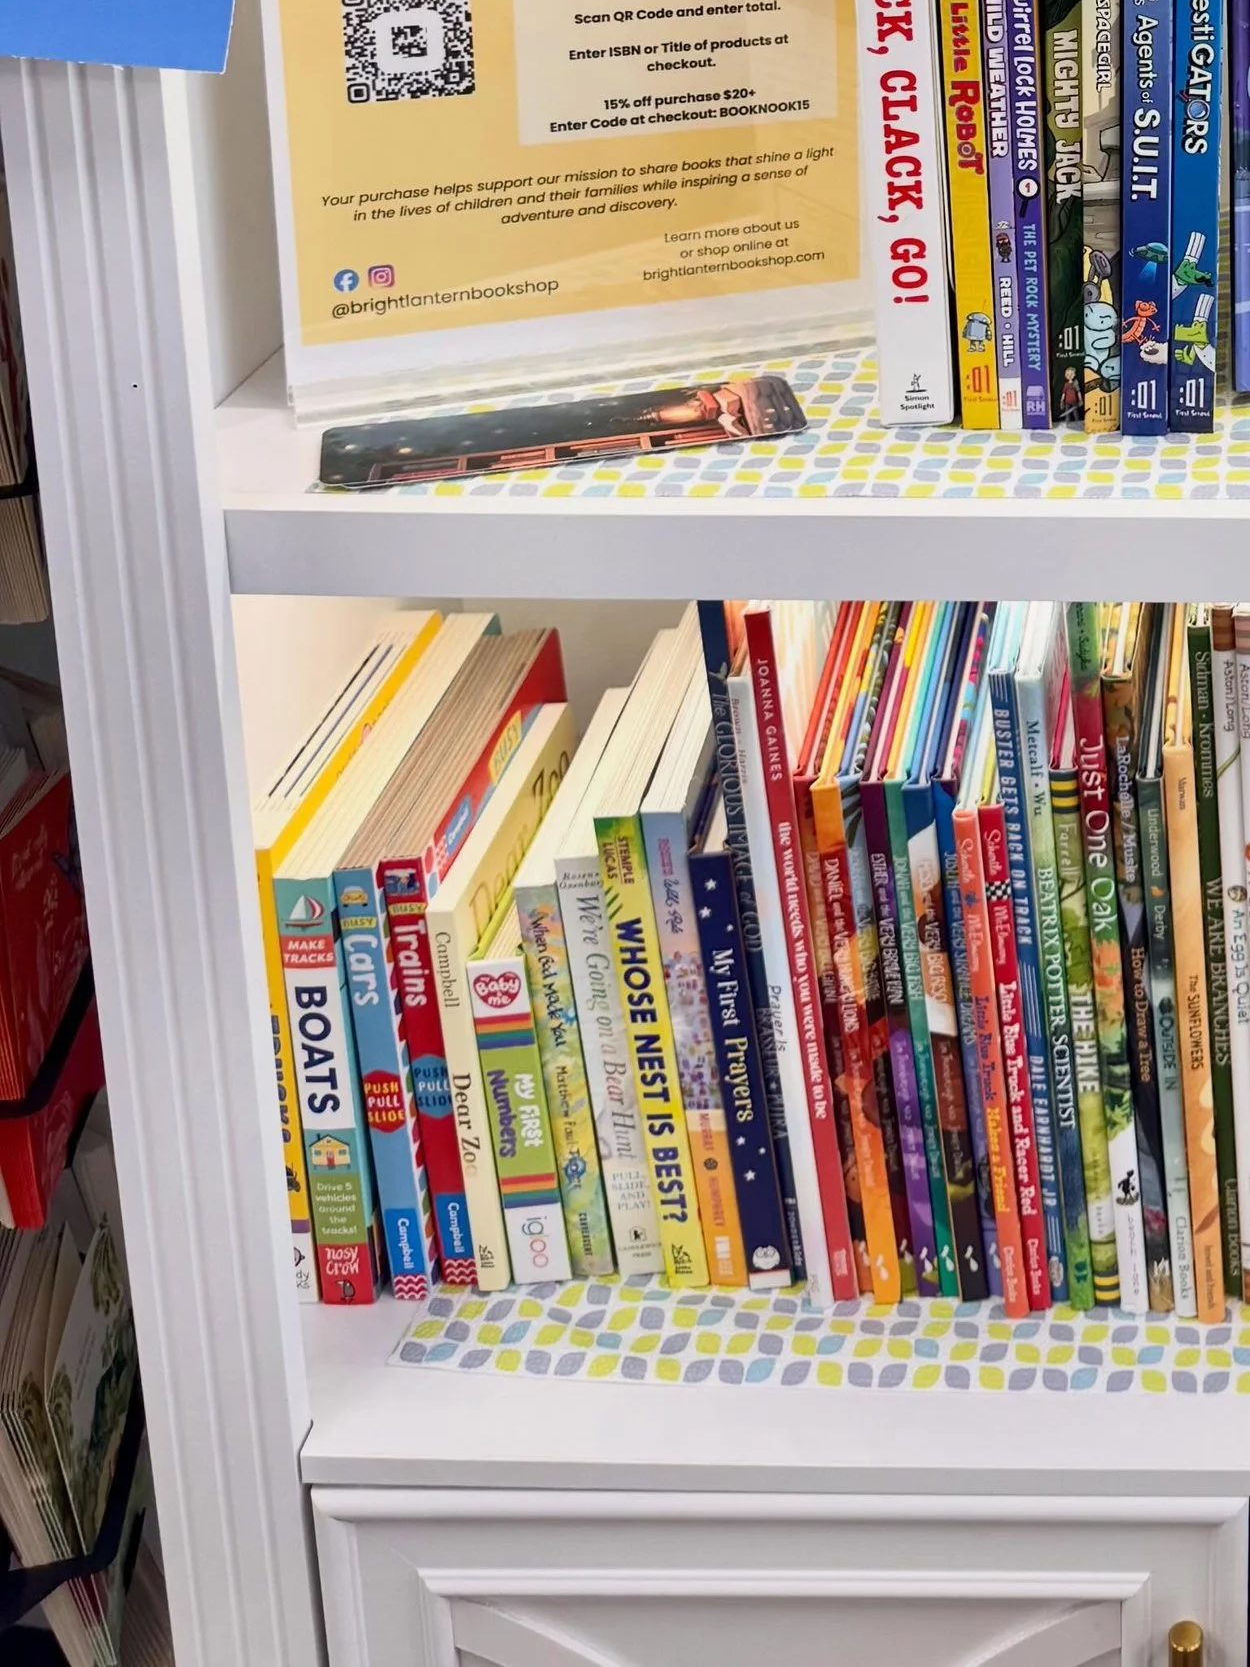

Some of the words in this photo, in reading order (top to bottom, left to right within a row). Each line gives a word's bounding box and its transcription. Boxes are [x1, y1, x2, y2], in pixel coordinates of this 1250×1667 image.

[573, 13, 611, 24] Scan
[612, 9, 634, 23] QR
[635, 7, 674, 20] Code
[675, 4, 704, 17] and
[705, 3, 744, 16] enter
[744, 0, 781, 12] total.
[568, 48, 607, 60] Enter
[608, 44, 641, 57] ISBN
[643, 44, 659, 55] or
[660, 40, 692, 53] Title
[692, 38, 708, 51] of
[709, 35, 772, 53] products
[773, 33, 789, 45] at
[646, 56, 716, 72] checkout.
[1136, 14, 1159, 89] Agents
[603, 97, 631, 110] 15%
[632, 94, 652, 108] off
[653, 91, 721, 109] purchase
[722, 87, 756, 101] $20+
[1052, 29, 1082, 130] MIGHTY
[1141, 90, 1153, 105] of
[549, 120, 588, 133] Enter
[589, 115, 628, 129] Code
[629, 113, 646, 125] at
[647, 107, 717, 124] checkout:
[718, 98, 810, 118] BOOKNOOK15
[877, 69, 925, 223] CLACK,
[1130, 106, 1161, 201] S.U.I.T.
[1055, 139, 1083, 204] JACK
[663, 230, 701, 243] Learn
[703, 226, 740, 239] more
[741, 220, 782, 235] about
[783, 219, 800, 230] us
[679, 248, 694, 259] or
[696, 244, 730, 258] shop
[731, 238, 773, 253] online
[774, 236, 789, 248] at
[642, 250, 825, 282] brightlanternbookshop.com
[888, 237, 931, 304] GO!
[330, 279, 559, 319] @brightlanternbookshop
[756, 658, 773, 722] JOANNA
[765, 725, 783, 782] GAINES
[283, 950, 335, 965] TRACKS
[286, 938, 326, 953] MAKE
[393, 921, 428, 1008] Trains
[708, 948, 735, 976] My
[341, 936, 379, 1007] Cars
[615, 917, 658, 1024] WHOSE
[716, 980, 739, 1027] First
[294, 984, 340, 1116] BOATS
[633, 1033, 670, 1103] NEST
[723, 1036, 754, 1123] Prayers
[646, 1113, 675, 1137] IS
[652, 1145, 688, 1224] BEST?
